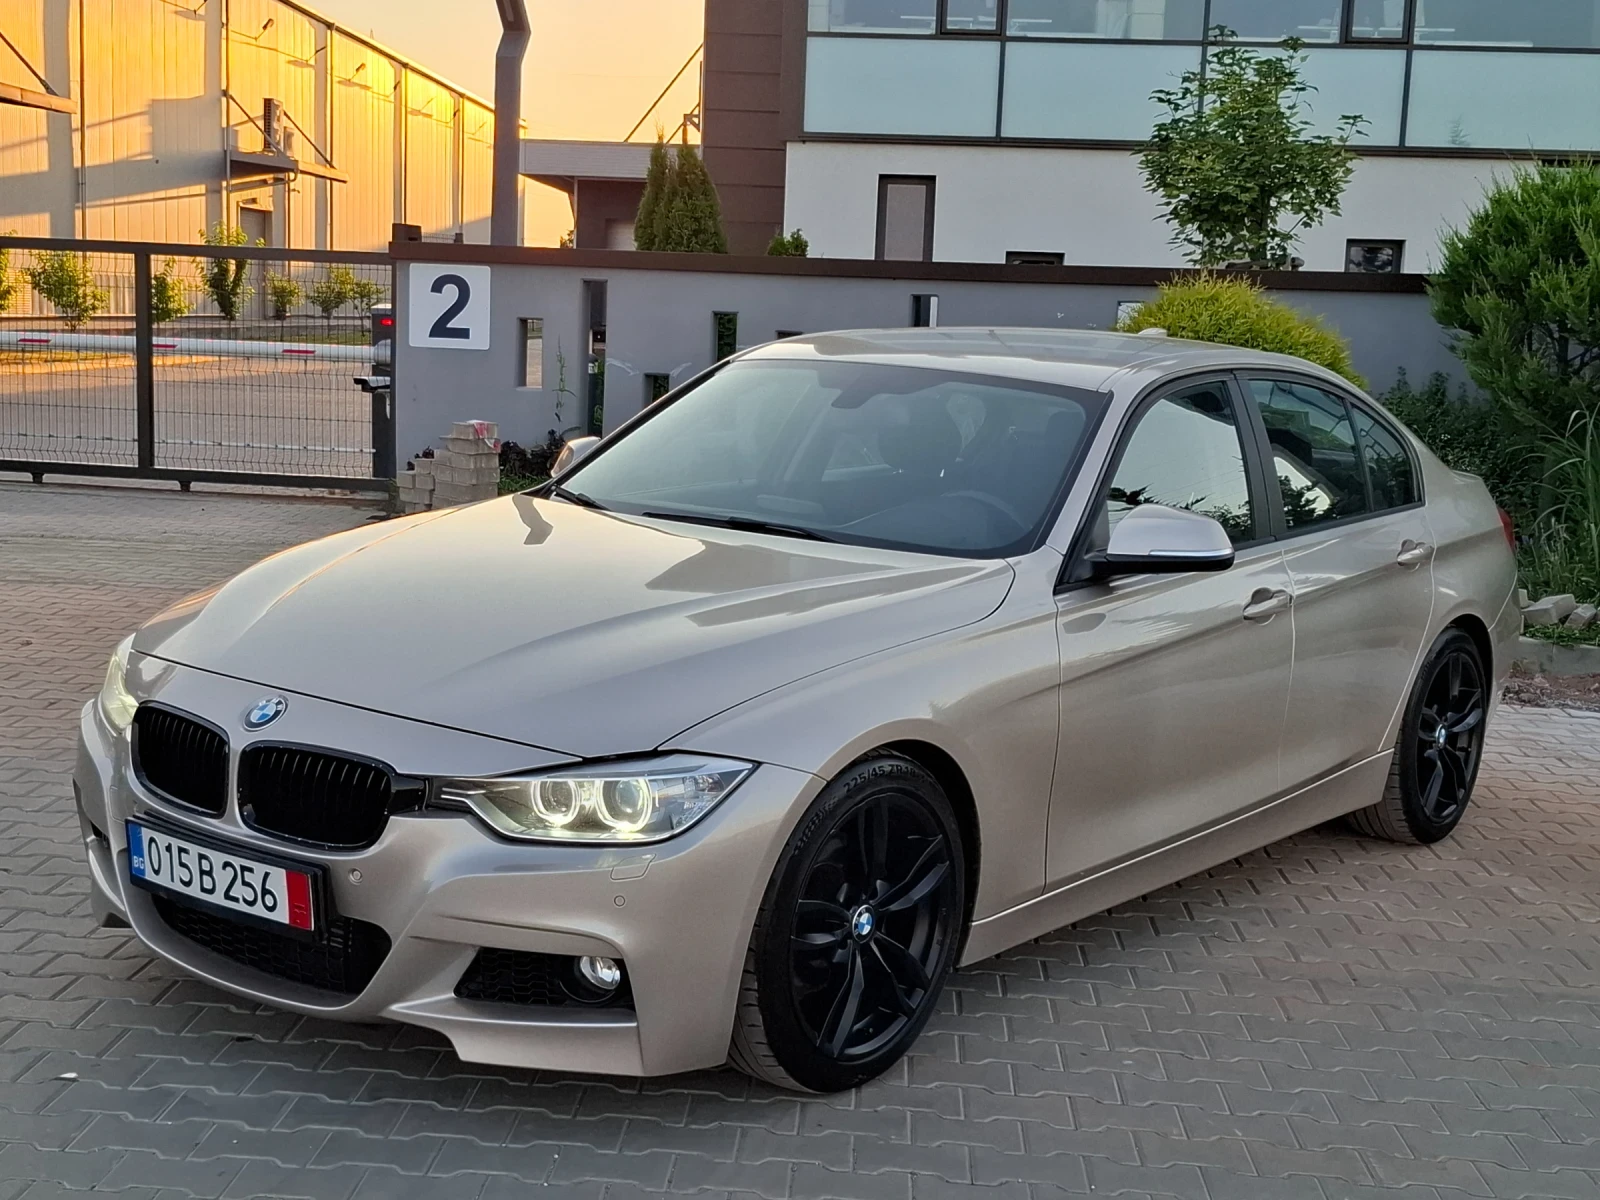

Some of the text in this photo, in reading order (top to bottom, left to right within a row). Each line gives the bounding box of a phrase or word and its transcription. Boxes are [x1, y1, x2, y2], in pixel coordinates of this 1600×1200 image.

[428, 273, 471, 340] 2
[133, 855, 145, 870] BG
[147, 835, 278, 913] 015B256
